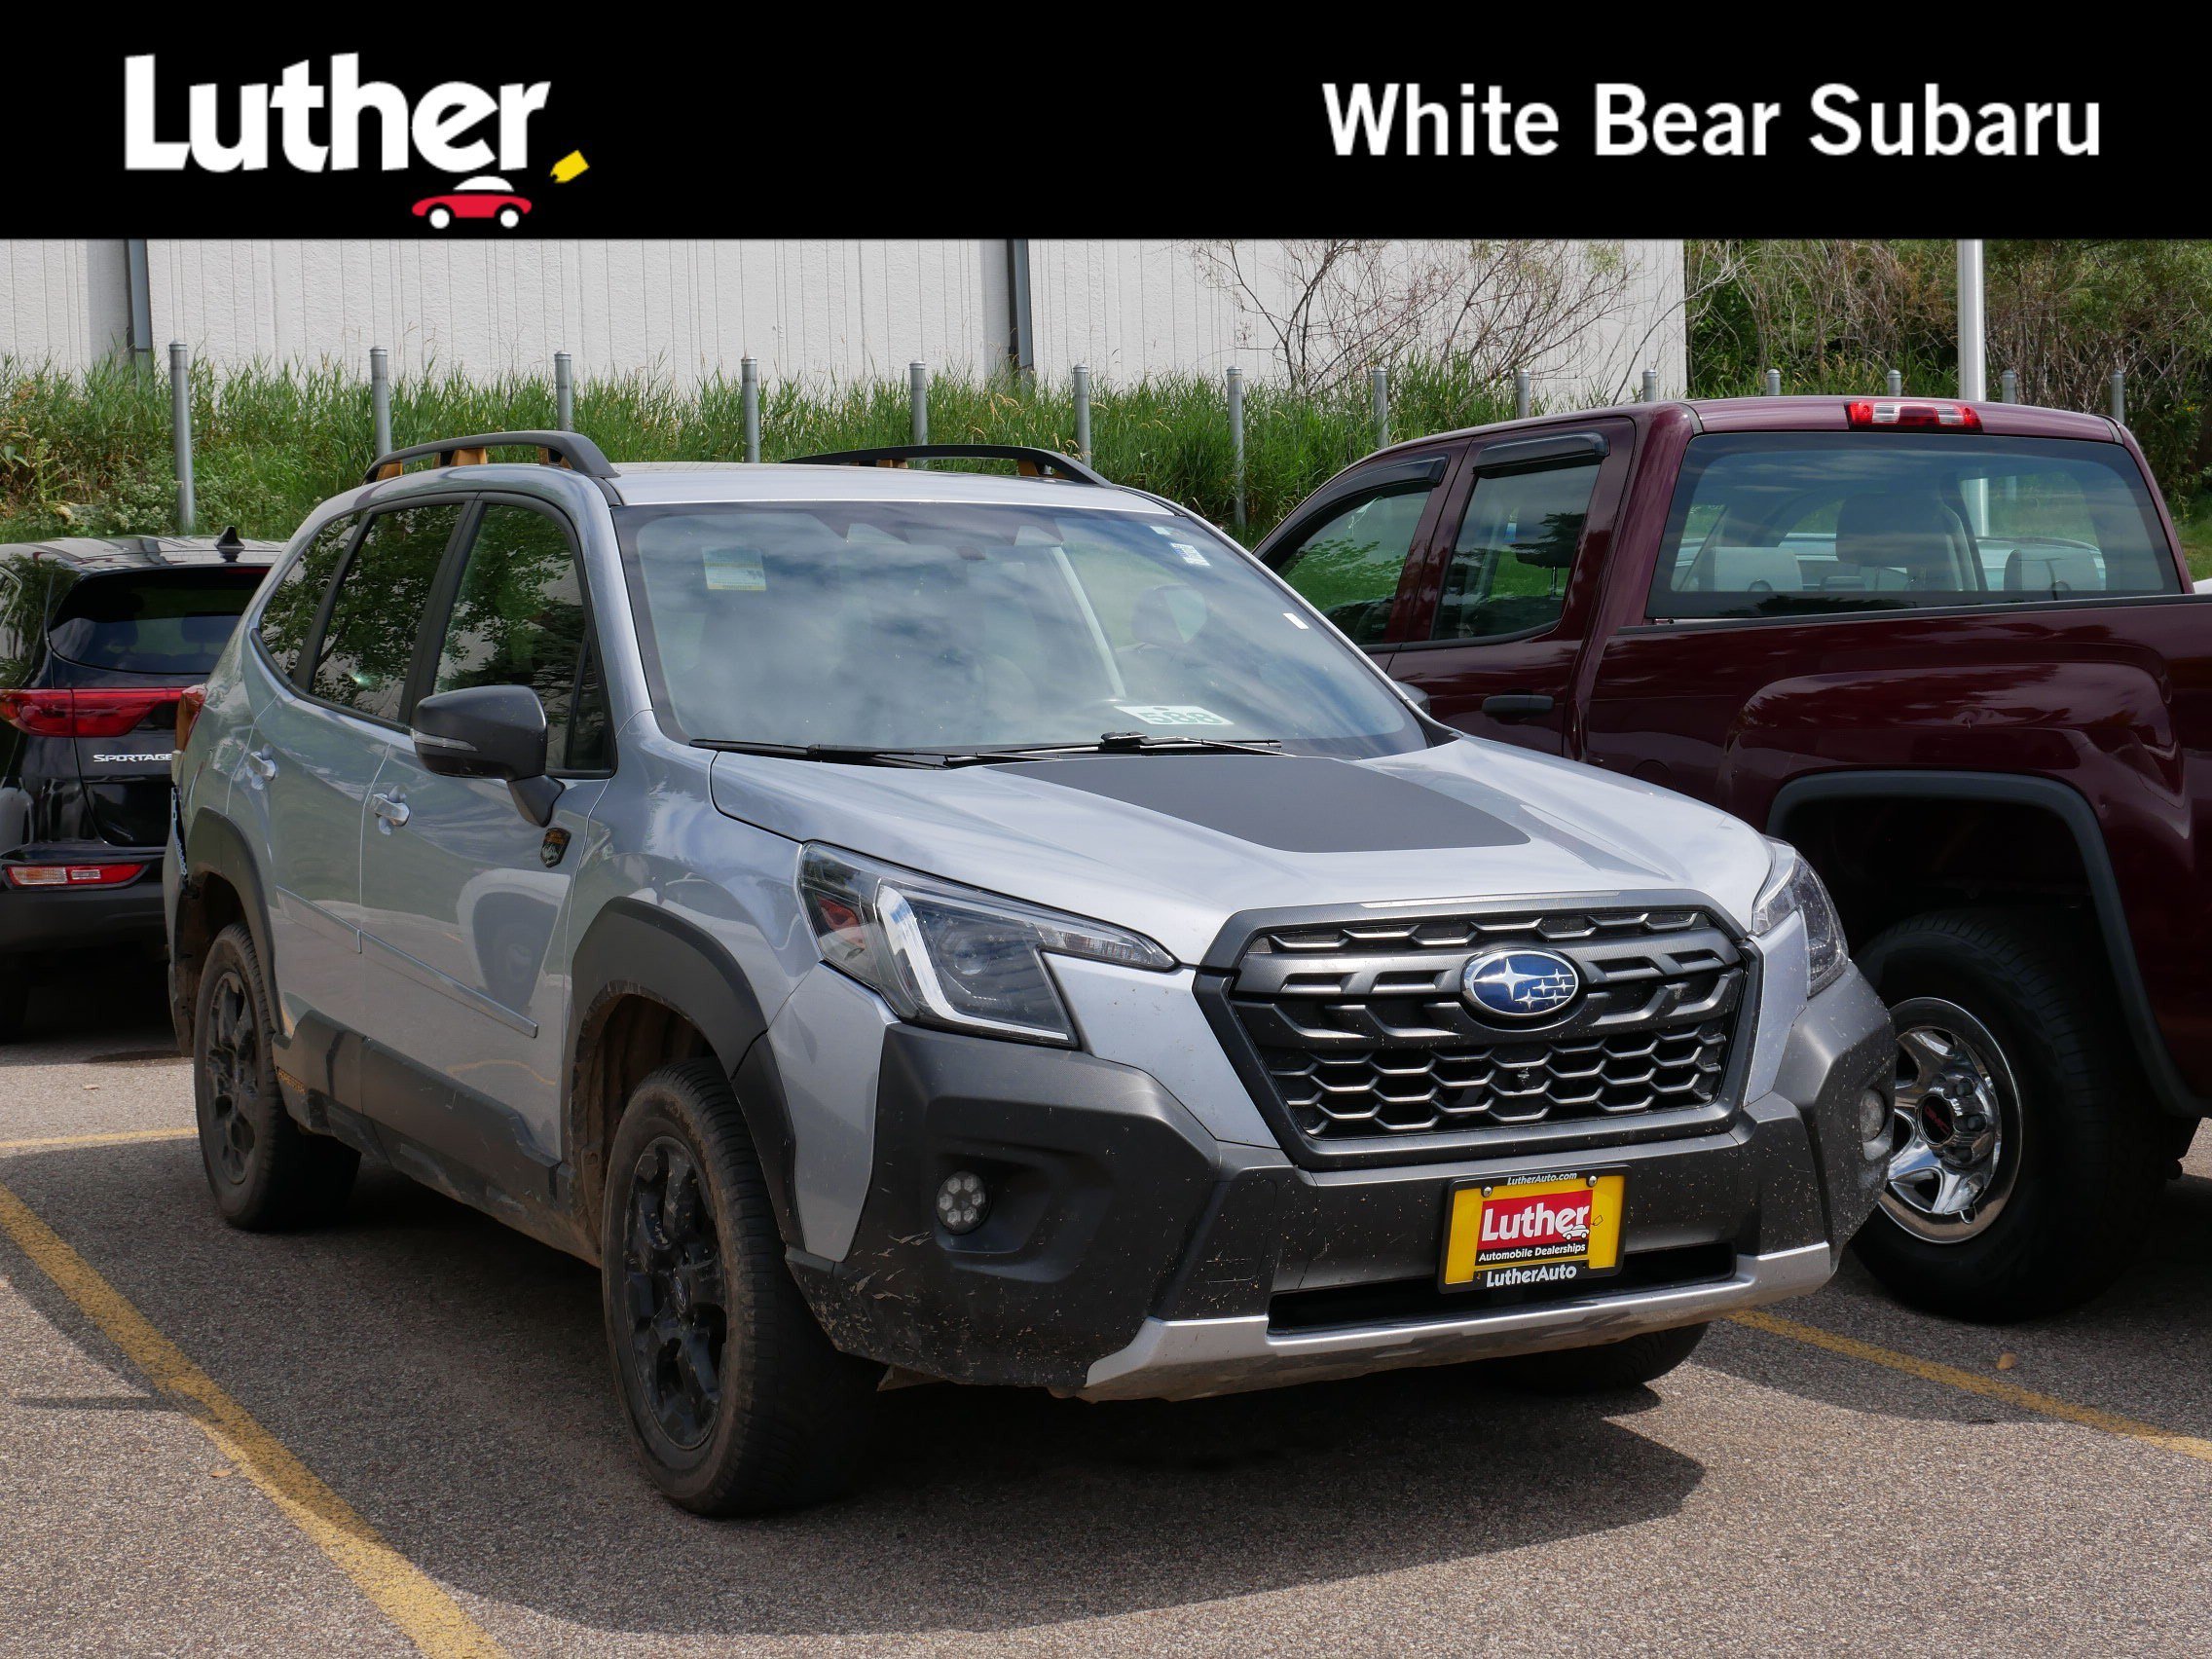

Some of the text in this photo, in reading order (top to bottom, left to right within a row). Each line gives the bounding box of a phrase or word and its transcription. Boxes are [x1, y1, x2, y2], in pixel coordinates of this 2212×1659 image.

[1137, 712, 1223, 724] 588
[93, 754, 172, 762] SPORTAGE
[1507, 1172, 1577, 1186] LutherAuto.com
[1482, 1202, 1590, 1241] Luther
[1479, 1243, 1586, 1262] Automobile Dealerships
[1487, 1264, 1577, 1287] LutherAuto
